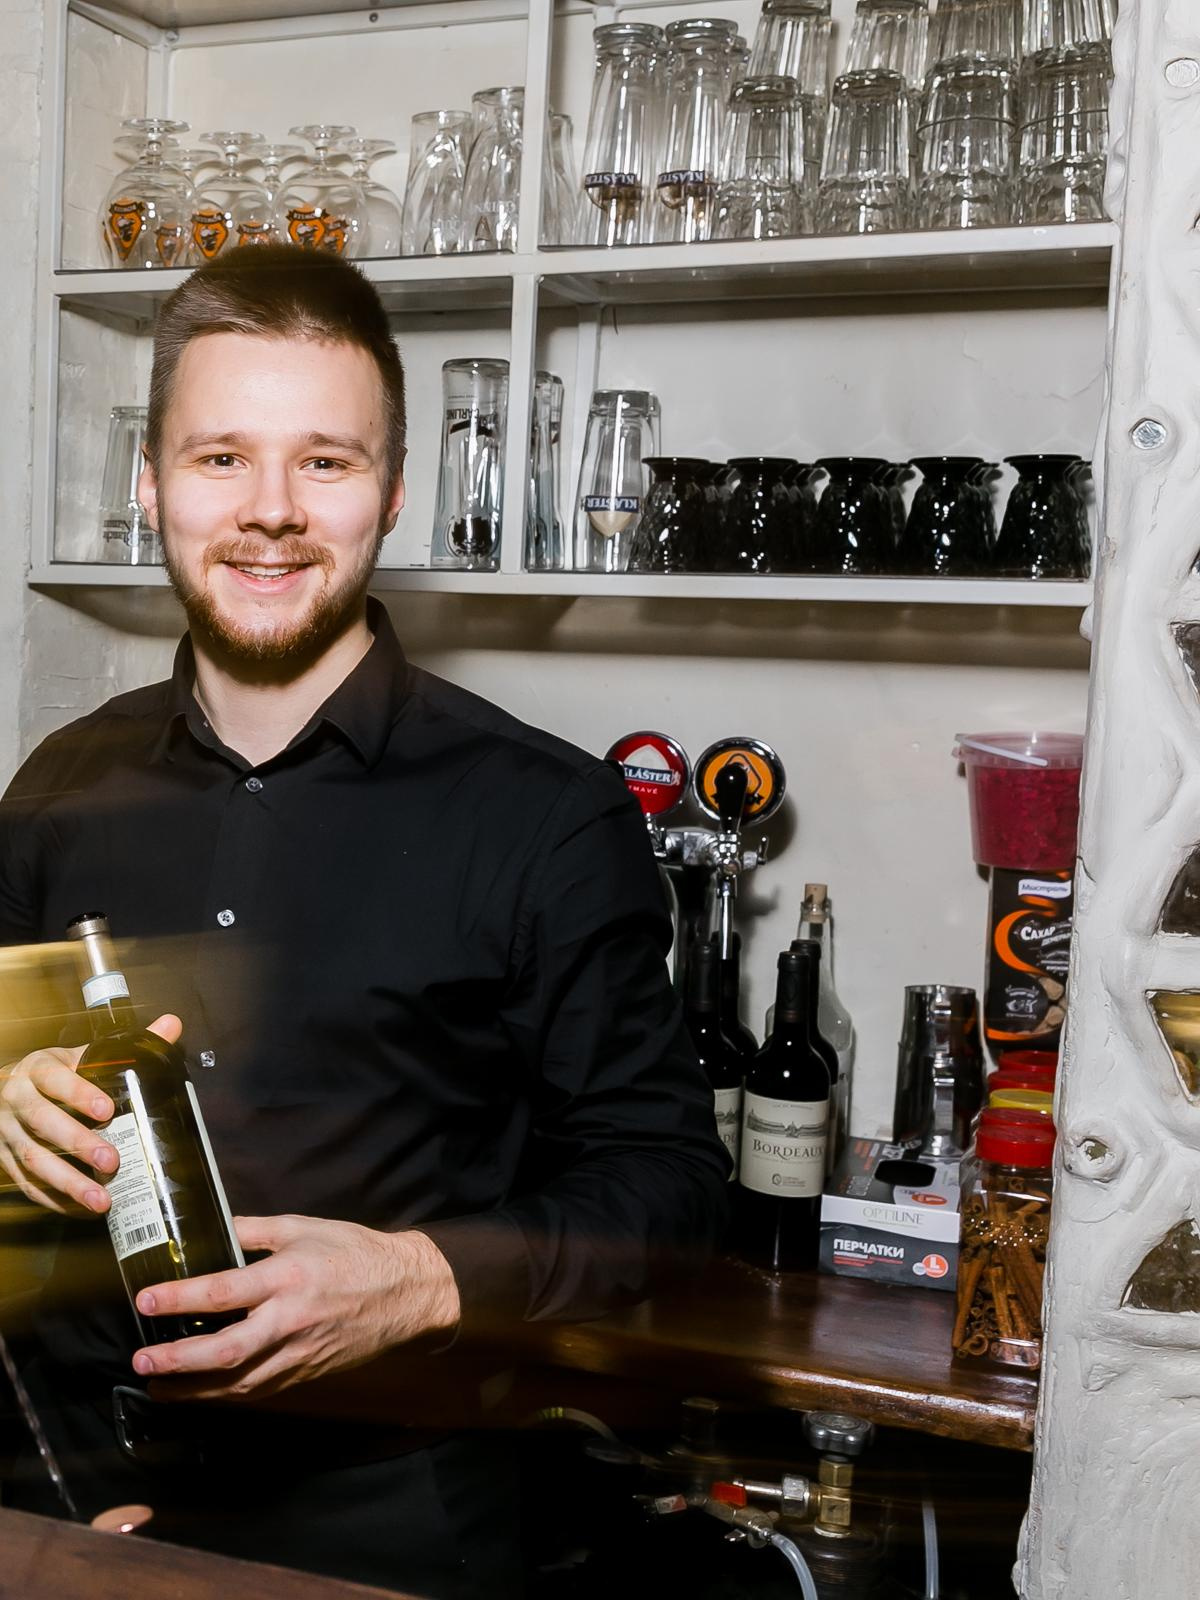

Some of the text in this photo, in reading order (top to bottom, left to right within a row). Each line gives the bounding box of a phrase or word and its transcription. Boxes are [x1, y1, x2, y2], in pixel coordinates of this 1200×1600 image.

[862, 1206, 924, 1225] OPTILINE
[833, 1238, 905, 1259] ПЕРЧАТКИ
[929, 1256, 940, 1269] L
